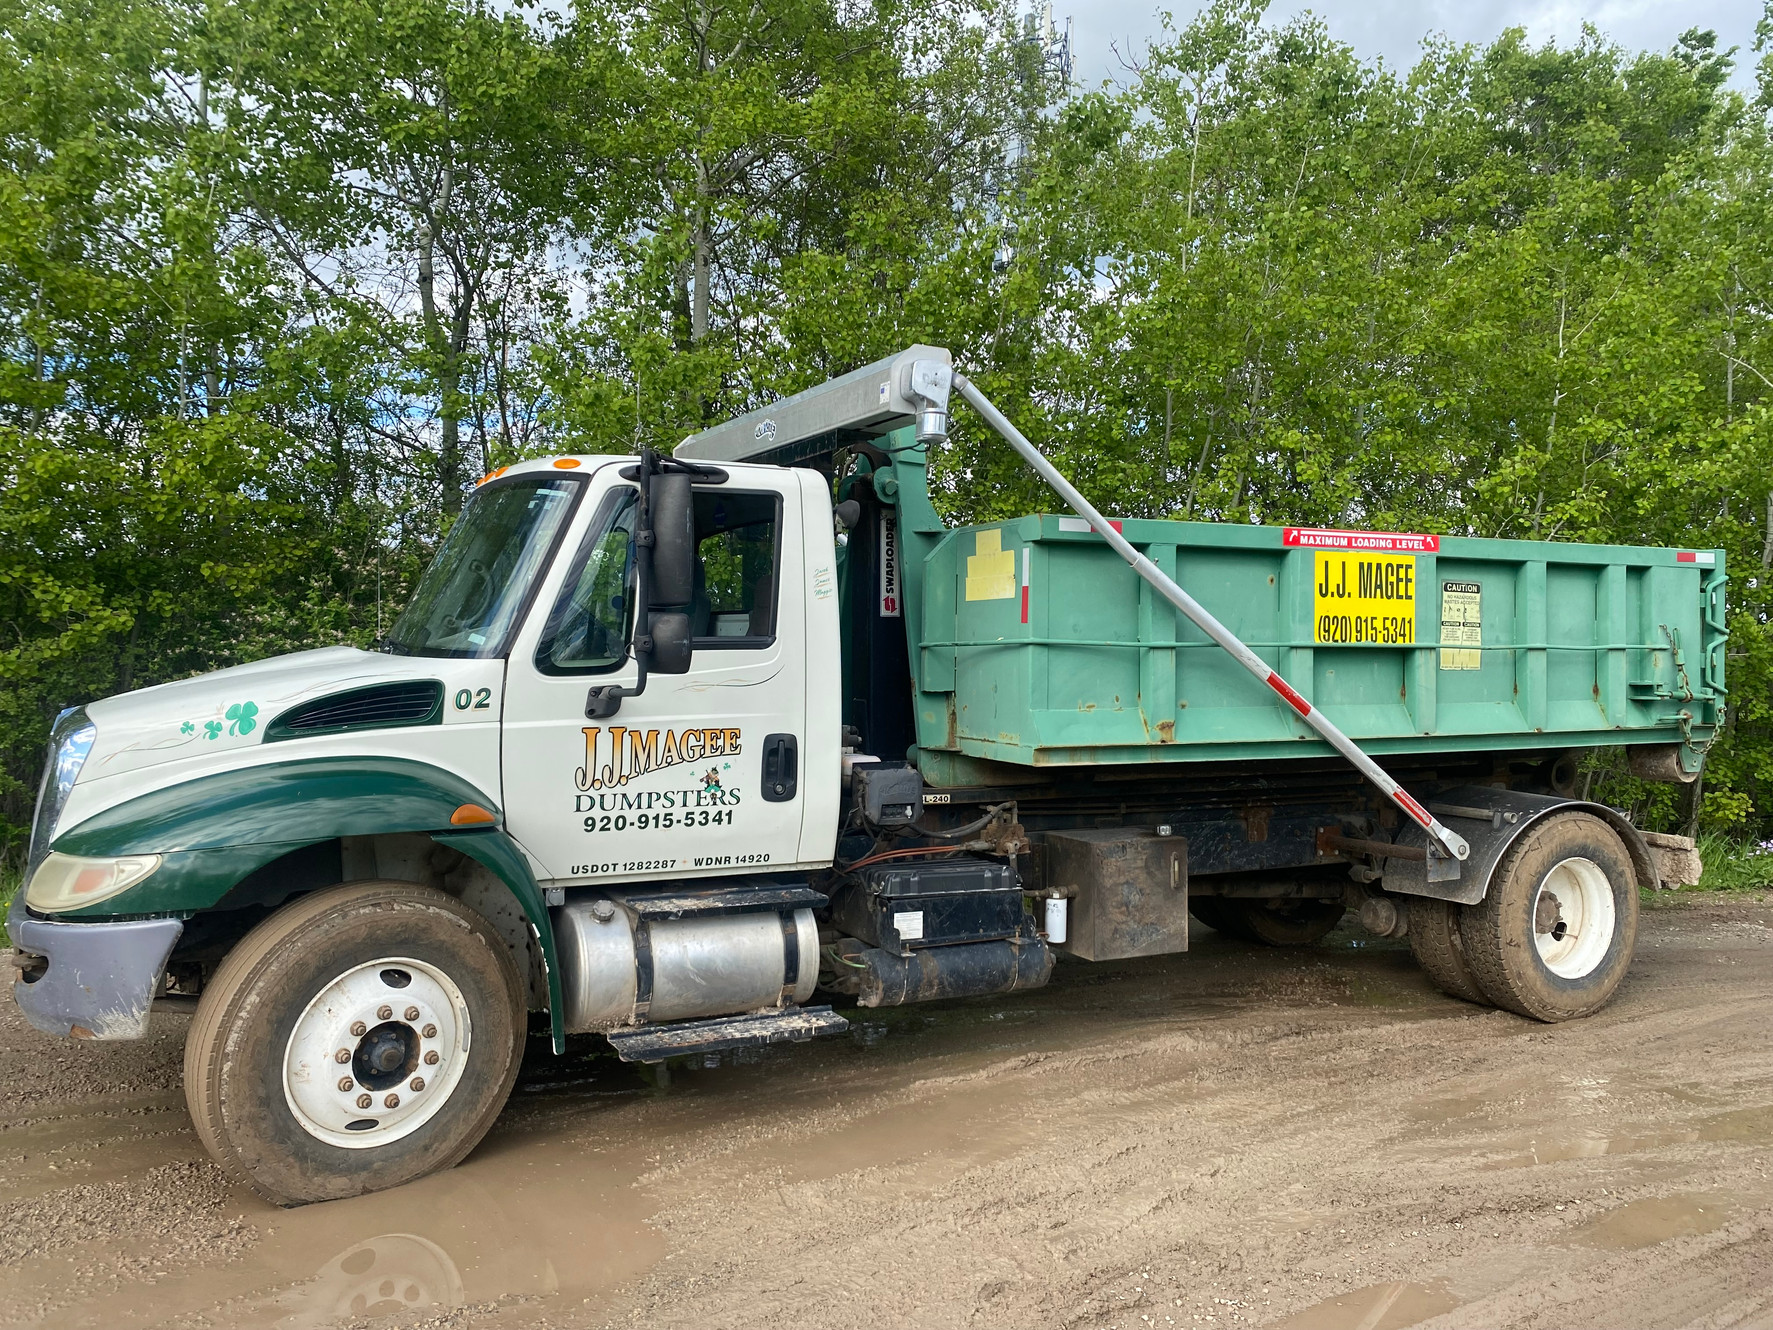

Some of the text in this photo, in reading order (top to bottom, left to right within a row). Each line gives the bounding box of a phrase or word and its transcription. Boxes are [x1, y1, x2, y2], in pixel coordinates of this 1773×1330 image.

[1300, 535, 1425, 549] MAXIMUM LOADING LEVEL
[886, 518, 895, 594] SWAPLOADER
[1318, 560, 1413, 600] J.J. MAGEE
[1447, 584, 1478, 592] CAUTION
[1318, 615, 1353, 643] (920)
[1355, 616, 1413, 643] 915-5341
[453, 687, 491, 711] 02
[627, 728, 742, 779] MAGEE
[574, 788, 741, 812] DUMPSTERS
[923, 795, 949, 803] L-240
[583, 810, 733, 833] 920-915-5341
[571, 853, 770, 875] USDOT 1282287 WDNR 14920
